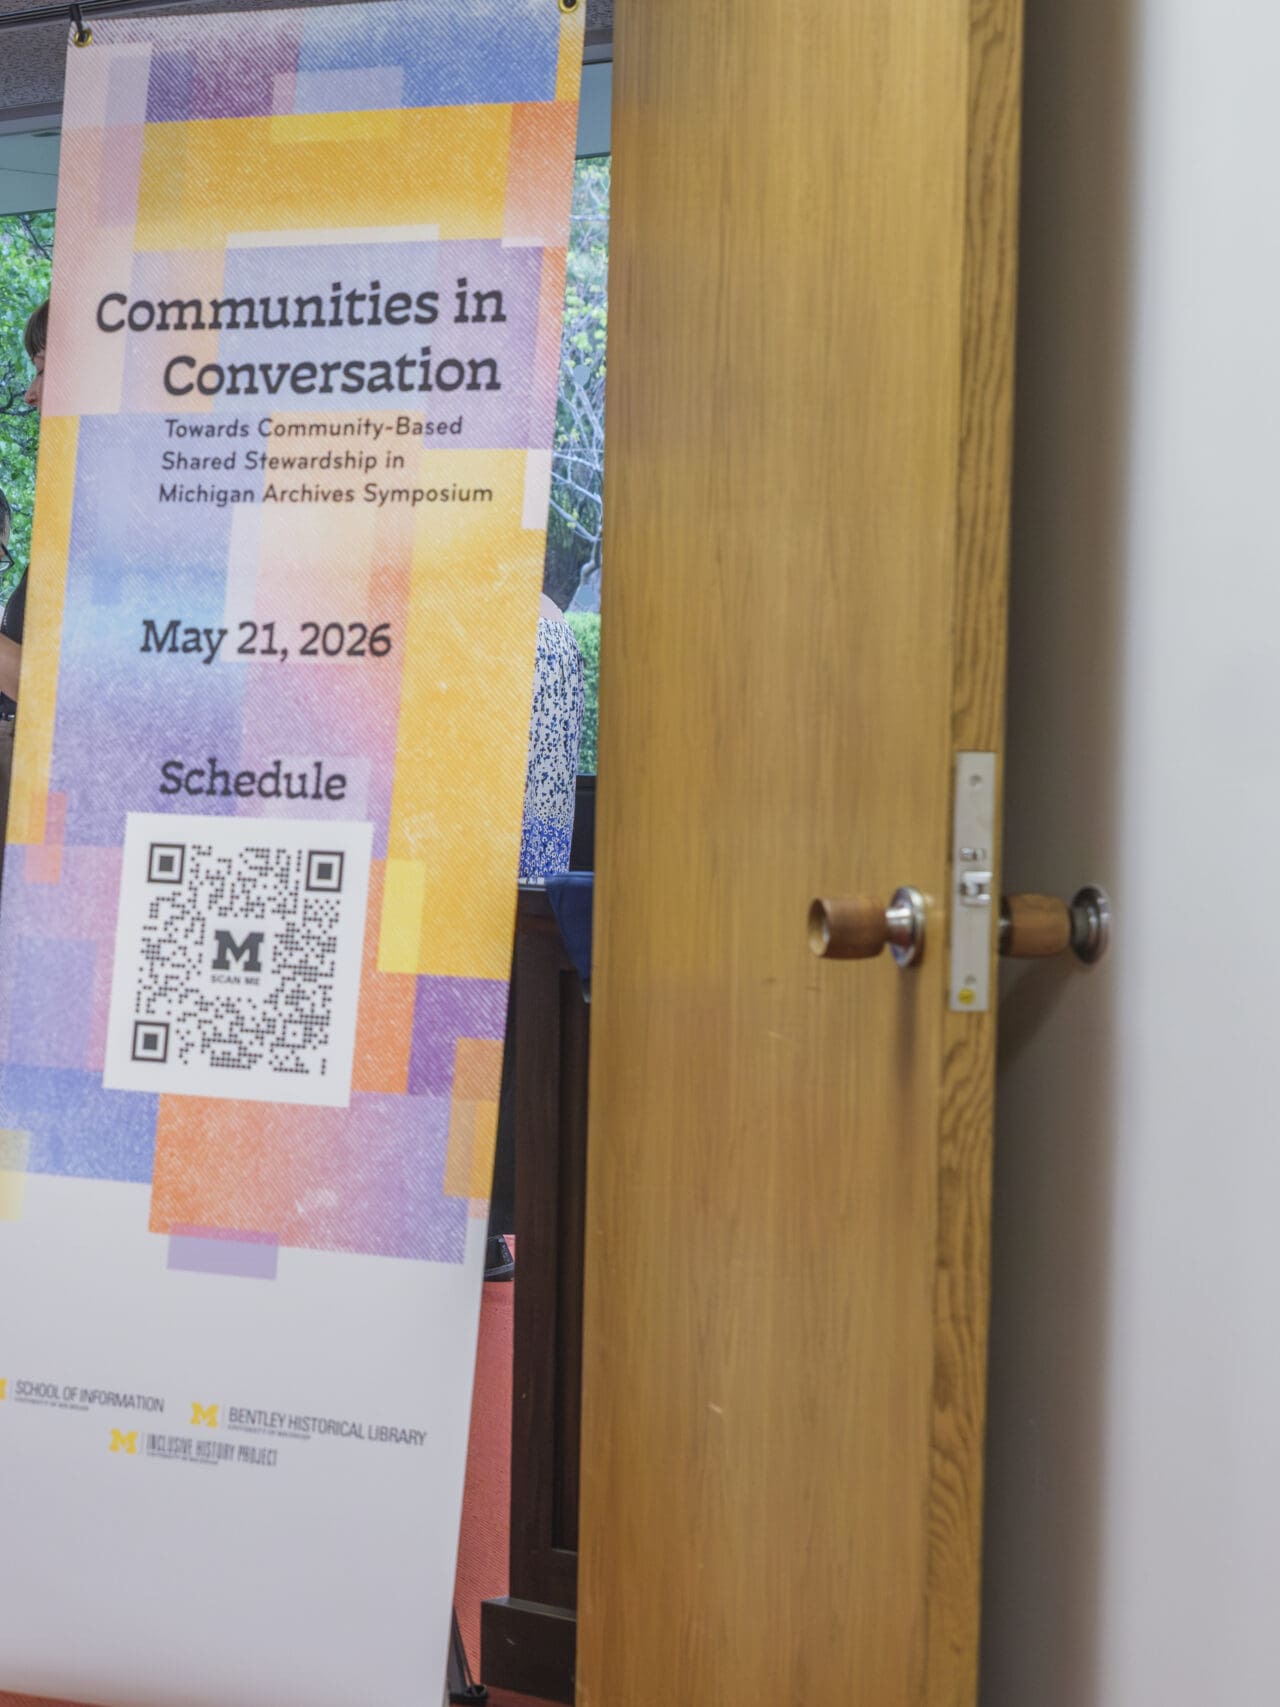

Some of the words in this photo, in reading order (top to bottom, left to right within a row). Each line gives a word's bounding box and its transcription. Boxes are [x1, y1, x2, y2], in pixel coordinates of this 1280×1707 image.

[96, 279, 440, 333] Communities
[453, 277, 508, 324] in
[163, 345, 502, 397] Conversation
[165, 418, 250, 439] Towards
[257, 415, 464, 440] Community-Based
[161, 450, 238, 471] Shared
[244, 449, 378, 475] Stewardship
[385, 450, 405, 469] in
[158, 483, 255, 508] Michigan
[261, 483, 355, 504] Archives
[363, 483, 494, 508] Symposium
[139, 619, 228, 665] May
[237, 621, 289, 663] 21,
[299, 621, 393, 658] 2026
[158, 756, 348, 801] Schedule
[212, 929, 265, 972] M
[15, 1380, 60, 1400] SCHOOL
[62, 1386, 78, 1401] OF
[80, 1389, 165, 1413] INFORMATION
[190, 1402, 219, 1428] M
[228, 1406, 287, 1428] BENTLEY
[287, 1415, 365, 1440] HISTORICAL
[367, 1424, 428, 1447] LIBRARY
[109, 1428, 138, 1454] M
[196, 1440, 235, 1462] HISTORY
[237, 1444, 278, 1467] PROJECT
